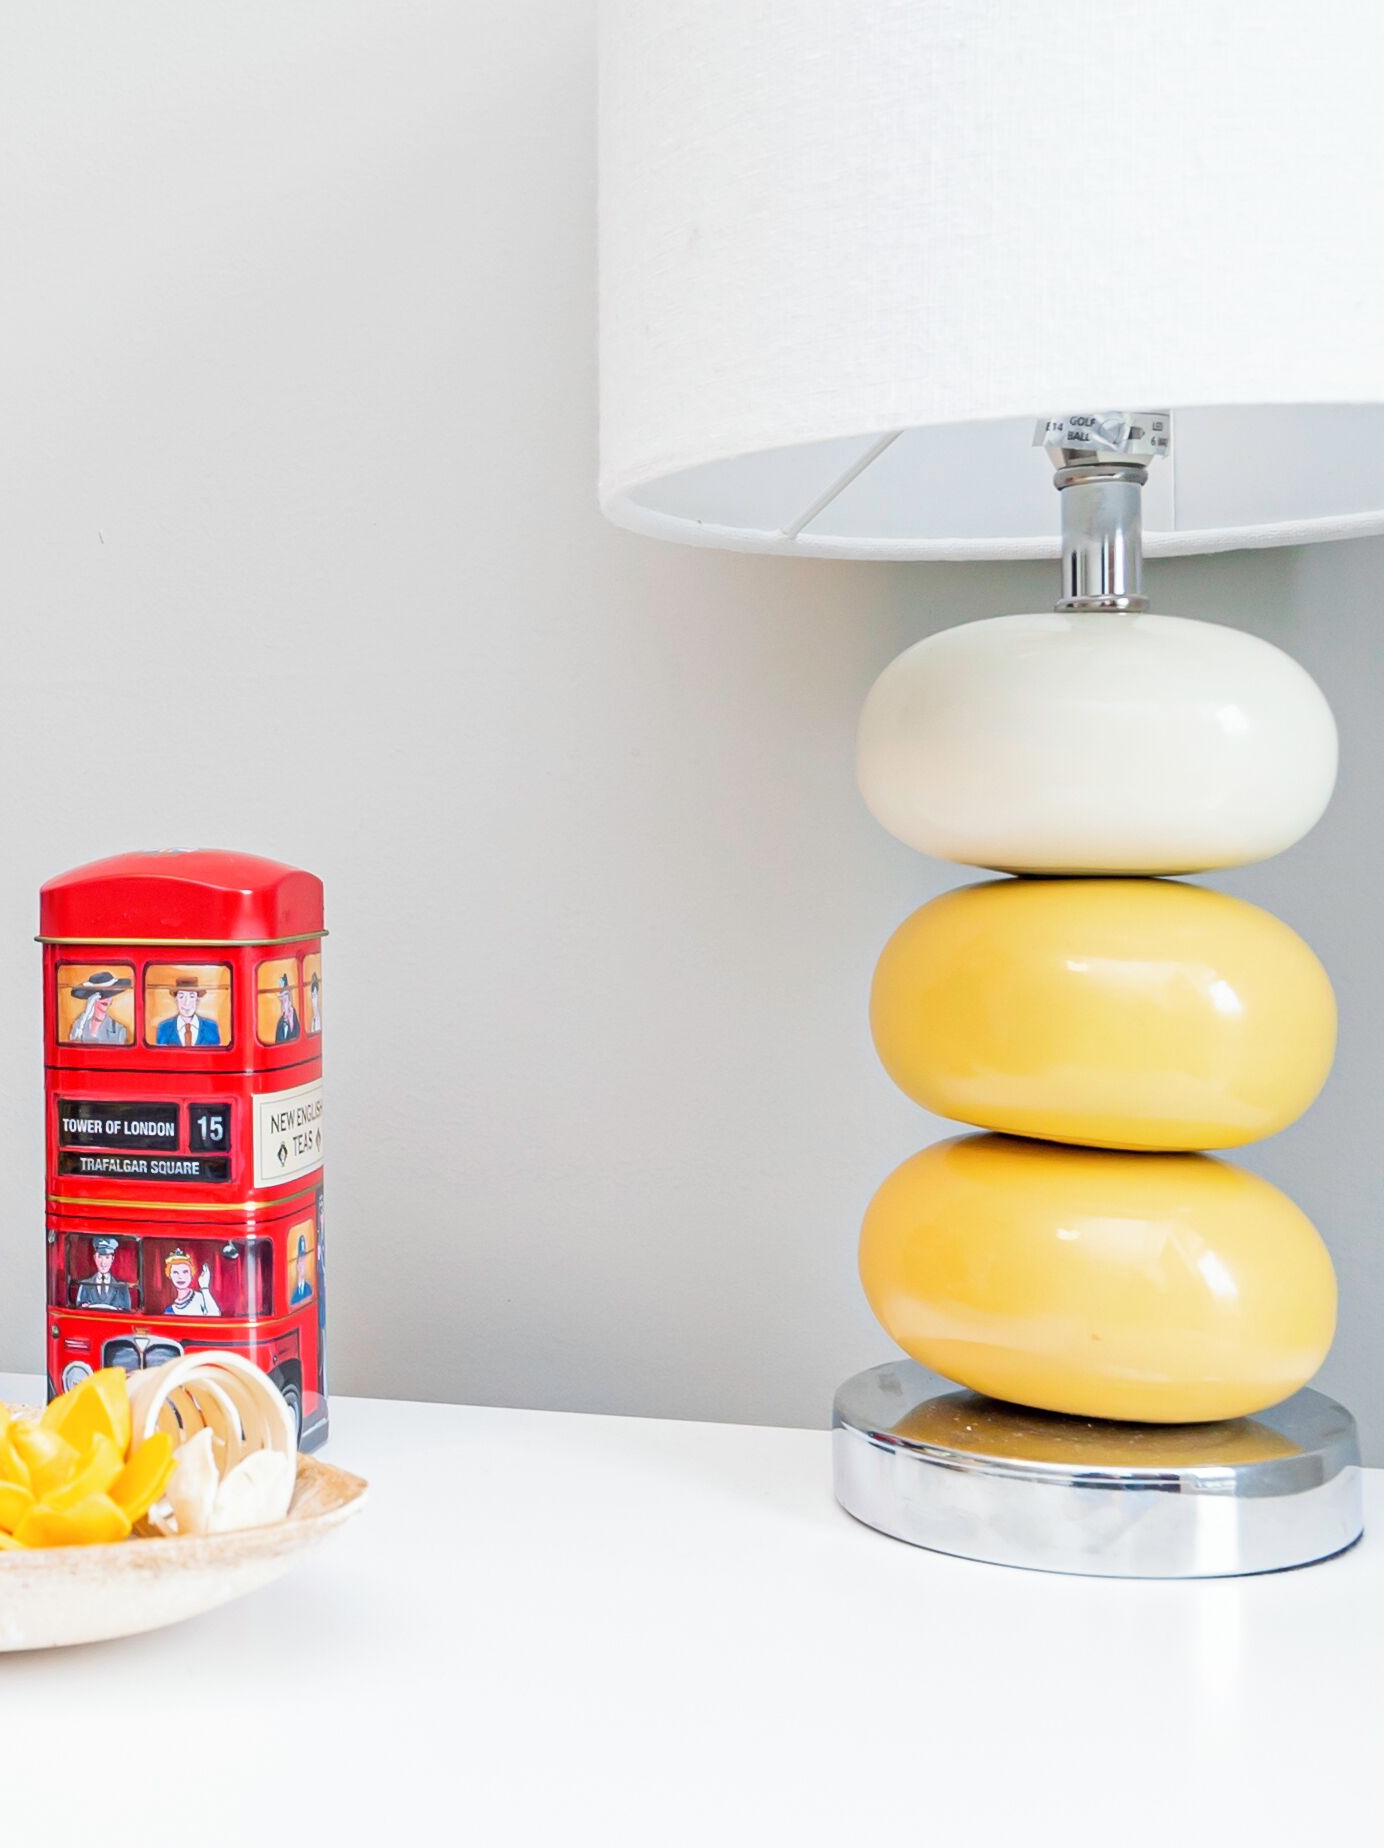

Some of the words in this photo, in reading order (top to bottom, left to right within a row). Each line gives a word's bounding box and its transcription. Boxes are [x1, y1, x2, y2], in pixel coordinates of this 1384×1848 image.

[1069, 416, 1096, 427] GOLF
[1067, 431, 1090, 441] BALL
[62, 1118, 102, 1134] TOWER
[106, 1120, 121, 1135] OF
[124, 1121, 175, 1137] LONDON
[197, 1115, 224, 1141] 15
[271, 1109, 295, 1134] NEW
[293, 1130, 313, 1157] TEAS
[80, 1157, 147, 1173] TRAFALGAR
[150, 1160, 200, 1175] SQUARE
